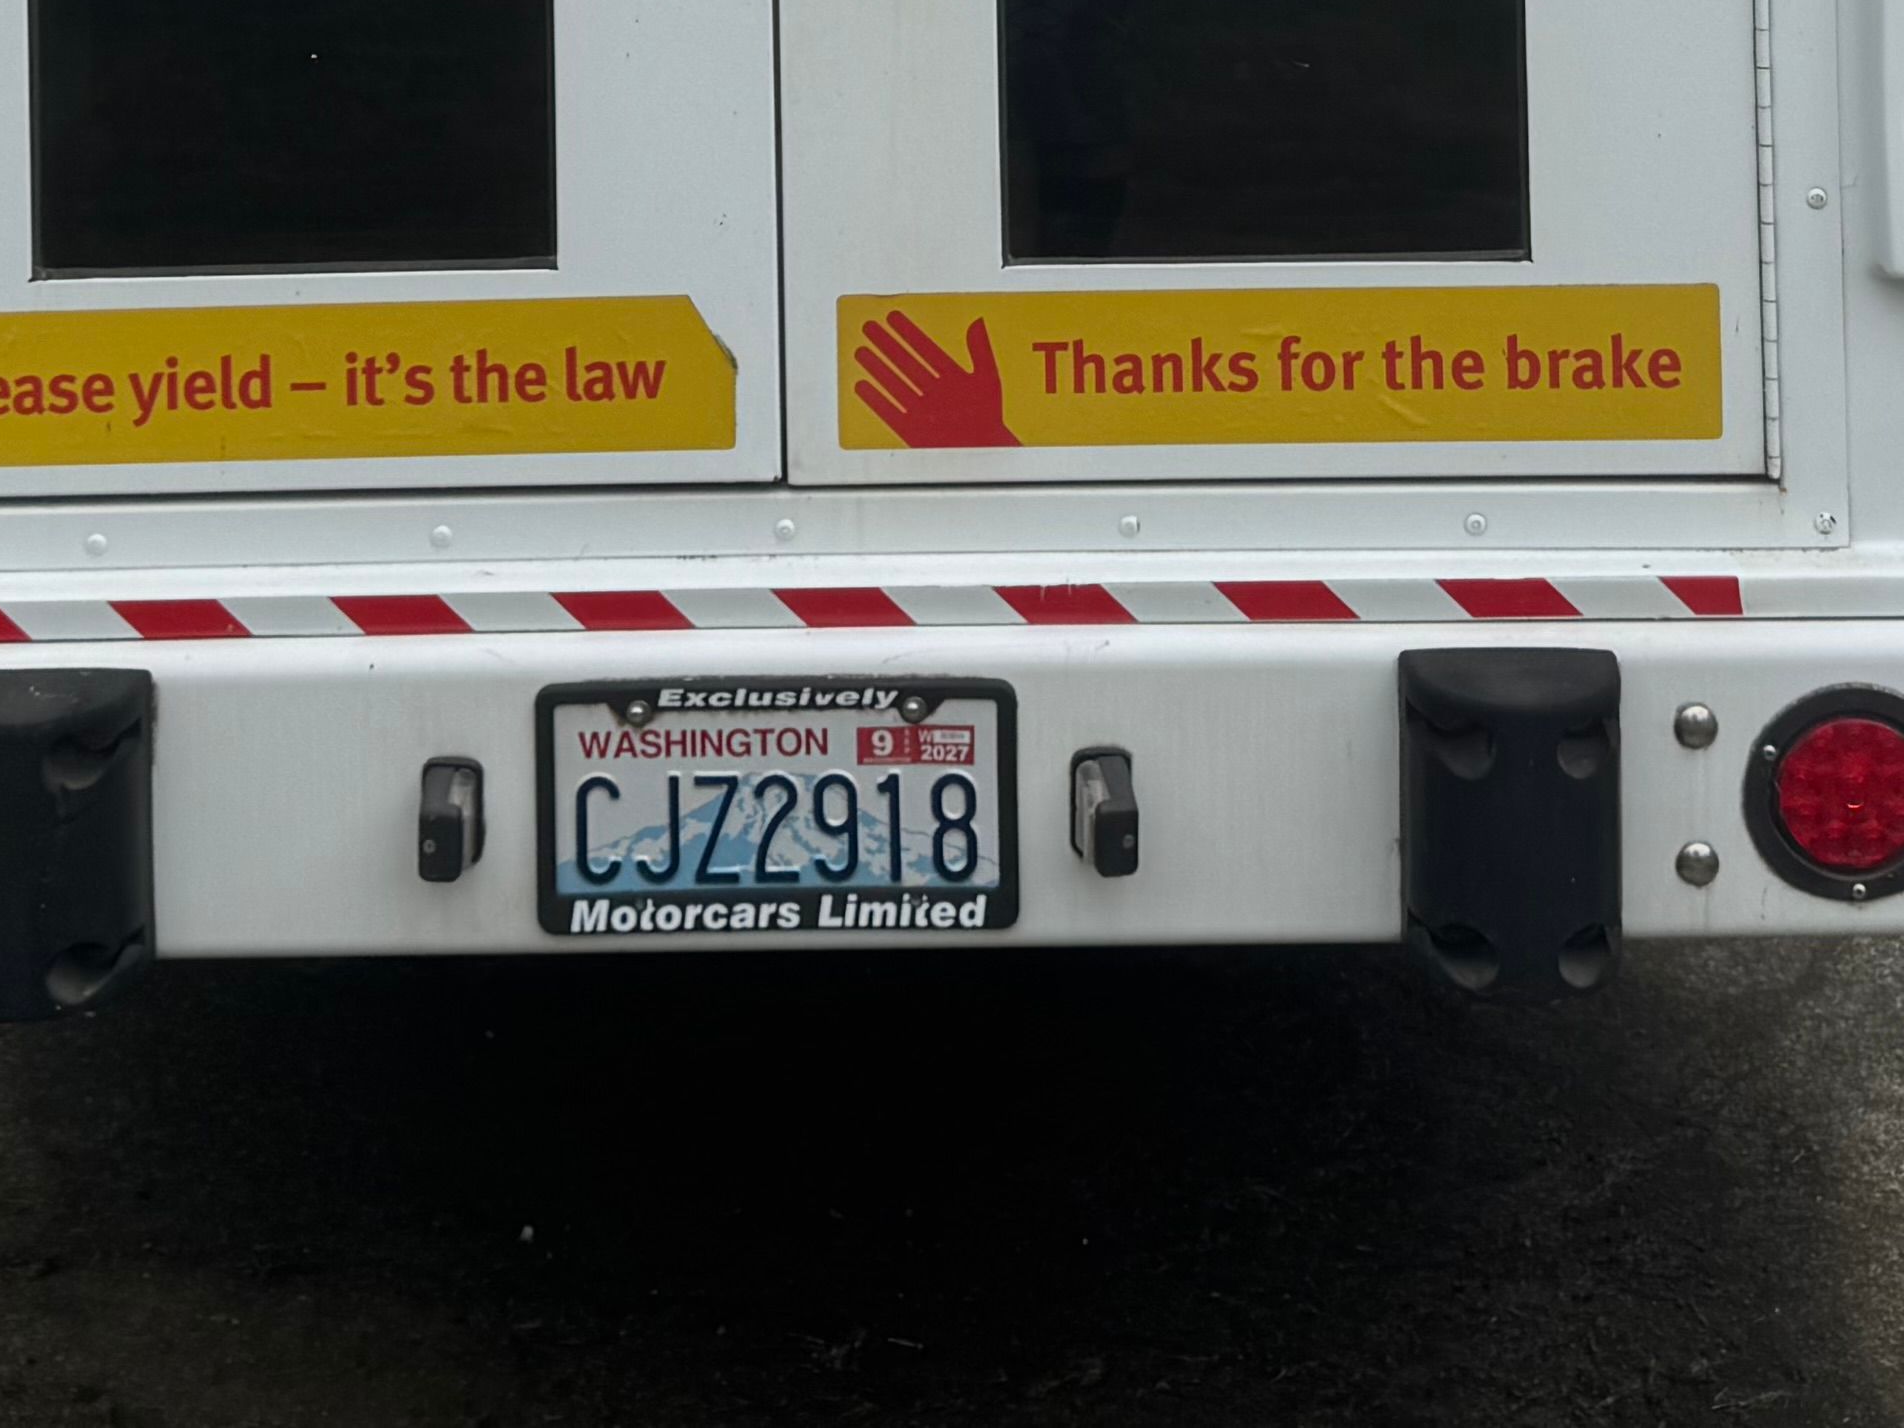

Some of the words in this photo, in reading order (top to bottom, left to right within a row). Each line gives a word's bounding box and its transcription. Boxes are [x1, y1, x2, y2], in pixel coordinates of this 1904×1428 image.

[1032, 337, 1260, 395] Thanks
[1277, 334, 1360, 392] for
[1384, 334, 1486, 390] the
[1505, 332, 1684, 389] brake
[129, 353, 273, 427] yield
[345, 352, 436, 407] it's
[452, 348, 548, 403] the
[566, 346, 667, 401] law
[657, 687, 899, 710] Exclusively
[577, 727, 829, 760] WASHINGTON
[871, 729, 894, 756] 9
[920, 744, 970, 762] 2027
[575, 769, 979, 884] CJZ2918
[569, 897, 801, 933] Motorcars
[817, 892, 987, 928] Limited
